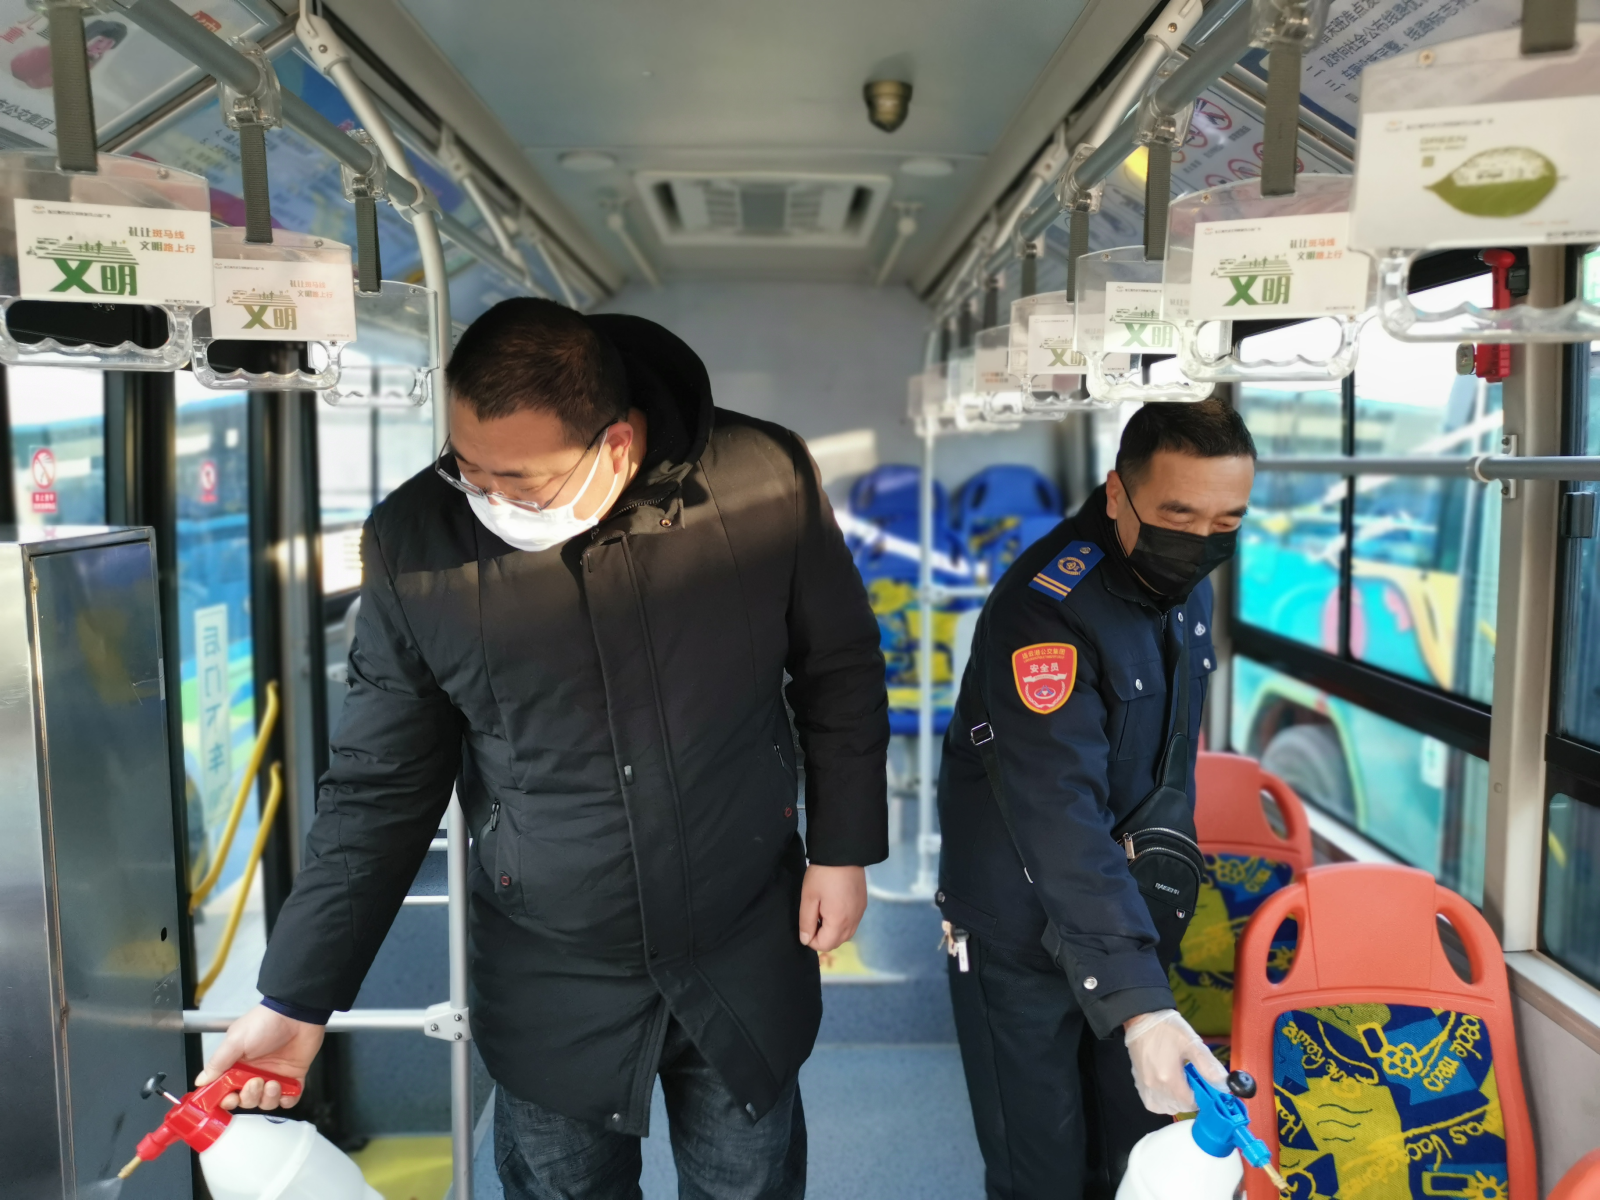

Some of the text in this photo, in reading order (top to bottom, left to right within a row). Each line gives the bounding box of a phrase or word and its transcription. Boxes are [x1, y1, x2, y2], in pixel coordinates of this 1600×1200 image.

[128, 226, 186, 240] 礼让斑马线
[139, 240, 197, 254] 文明路上行
[1289, 238, 1337, 250] 礼让斑马线
[1296, 250, 1343, 262] 文明路上行
[48, 257, 138, 297] 文明
[1222, 275, 1292, 308] 文明
[241, 304, 298, 331] 文明
[1120, 322, 1174, 348] 文明
[1029, 662, 1060, 674] 安全员
